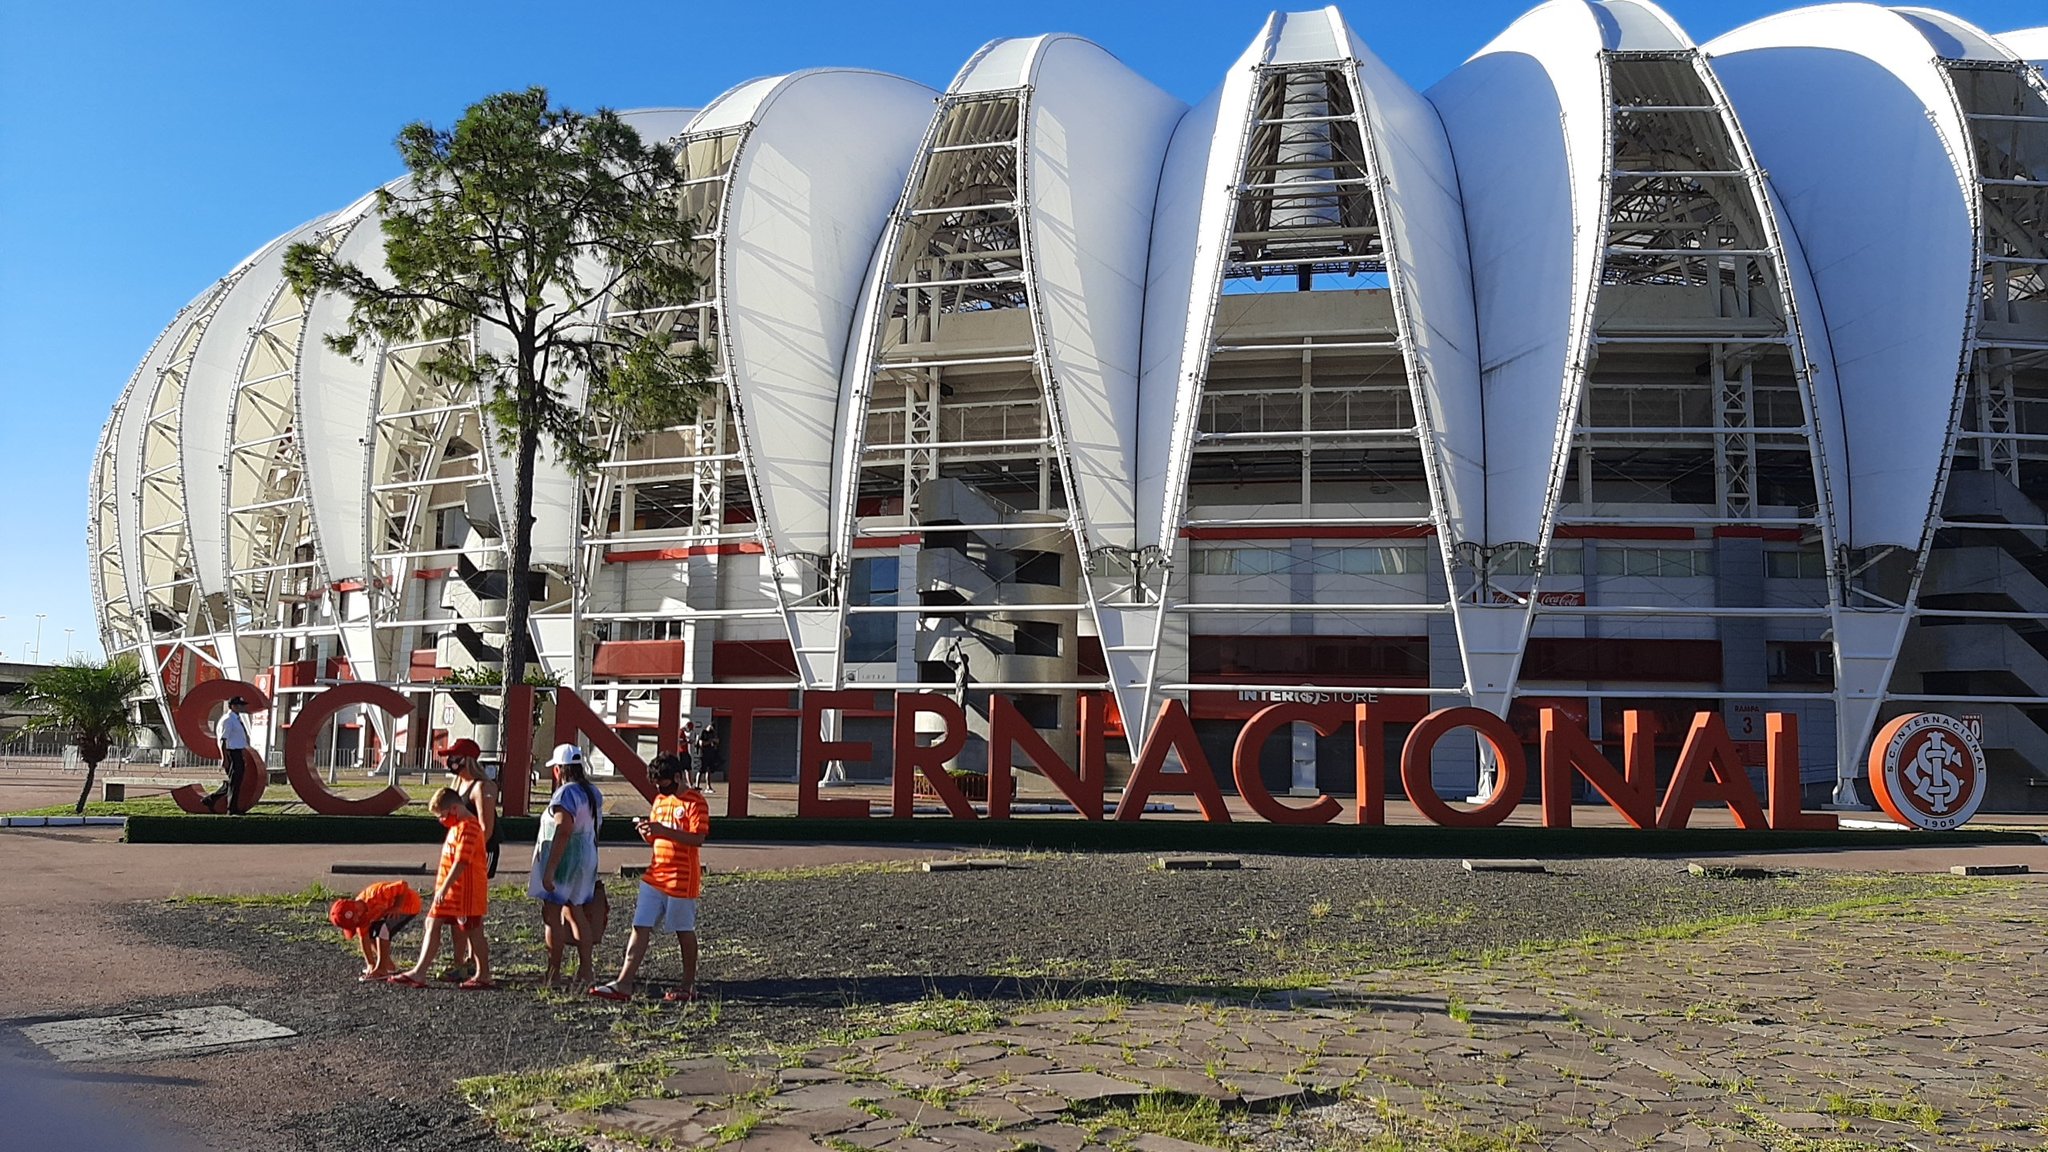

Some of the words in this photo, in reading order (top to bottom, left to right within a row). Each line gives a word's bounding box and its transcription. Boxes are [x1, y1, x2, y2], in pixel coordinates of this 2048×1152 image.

[1734, 704, 1760, 713] RAMPA
[1742, 716, 1753, 734] 3
[1894, 715, 1984, 774] INTERNACIONAL
[503, 685, 1840, 831] INTERNACIONAL
[1923, 818, 1955, 828] 1909
